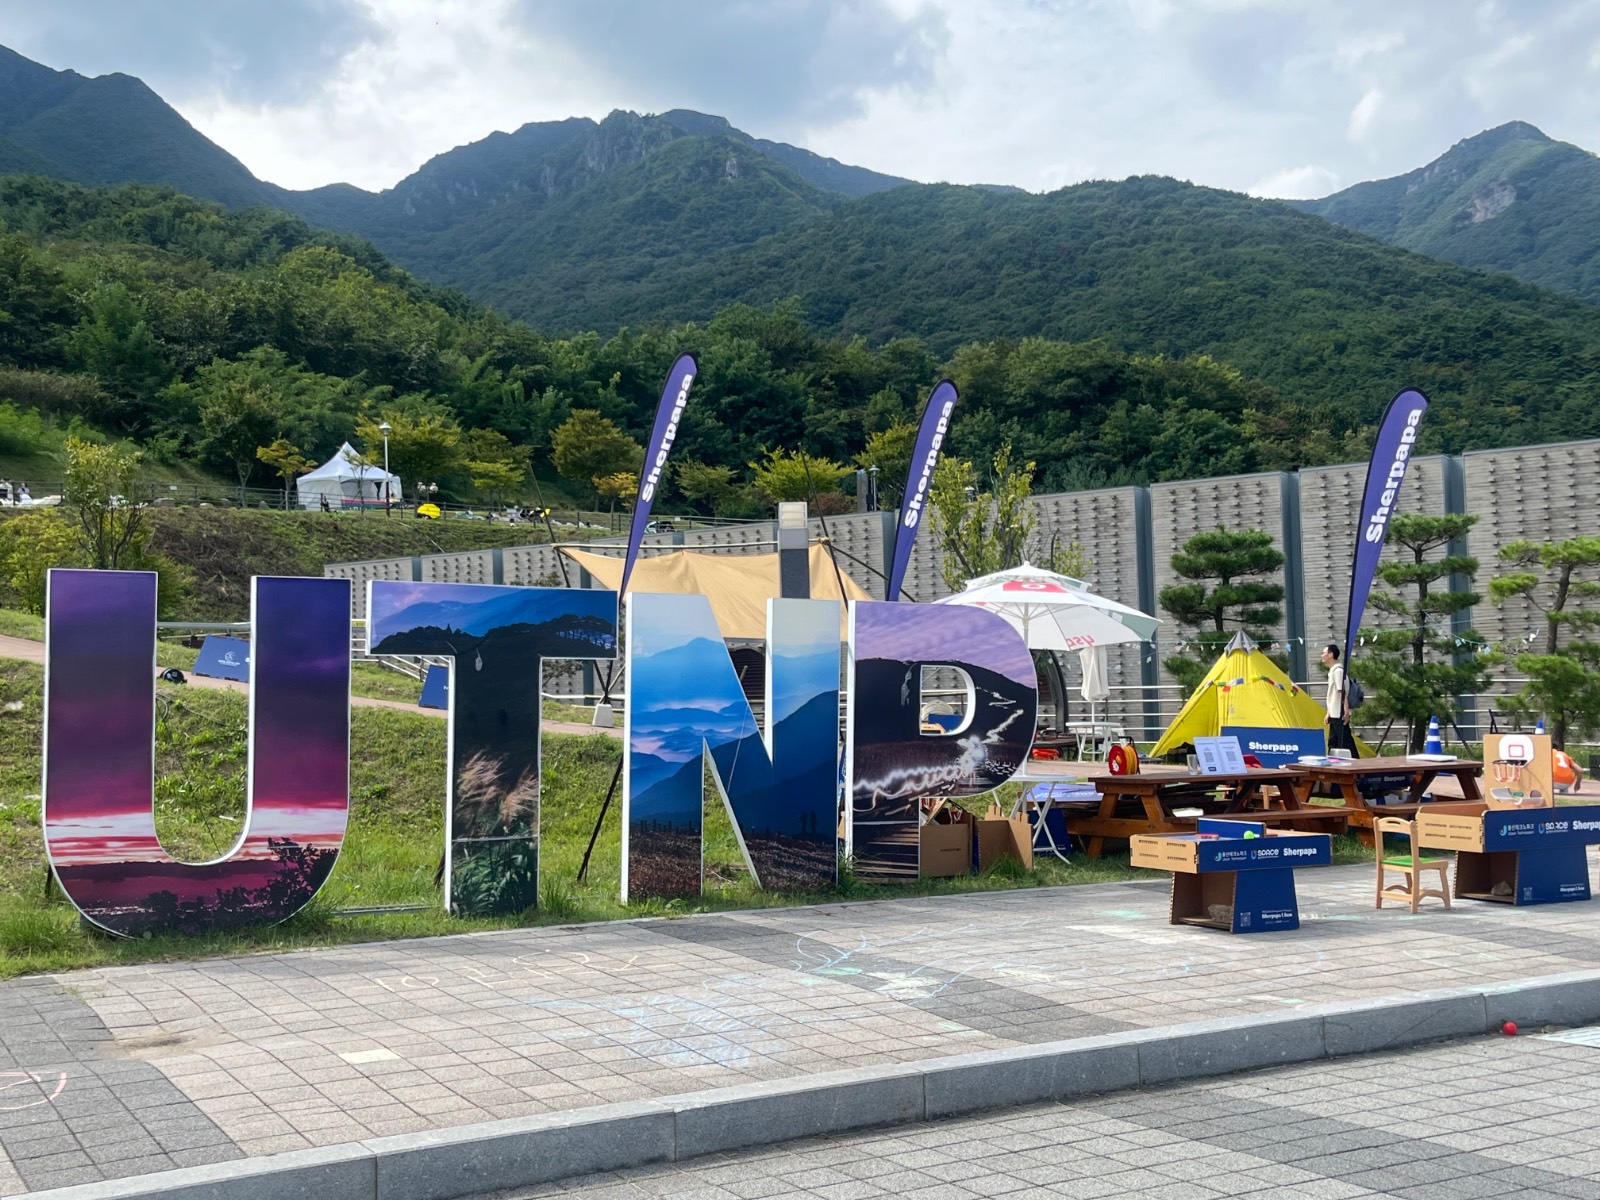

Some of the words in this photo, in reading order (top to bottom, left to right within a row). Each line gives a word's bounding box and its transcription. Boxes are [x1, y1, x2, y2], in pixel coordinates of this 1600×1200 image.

[641, 373, 693, 503] Sherpapa
[904, 401, 954, 529] Sherpapa
[1365, 408, 1423, 544] Sherpapa
[42, 568, 1040, 938] UTNP
[1248, 741, 1299, 753] Sherpapa
[1556, 753, 1569, 768] 1
[1283, 847, 1317, 857] Sherpapa
